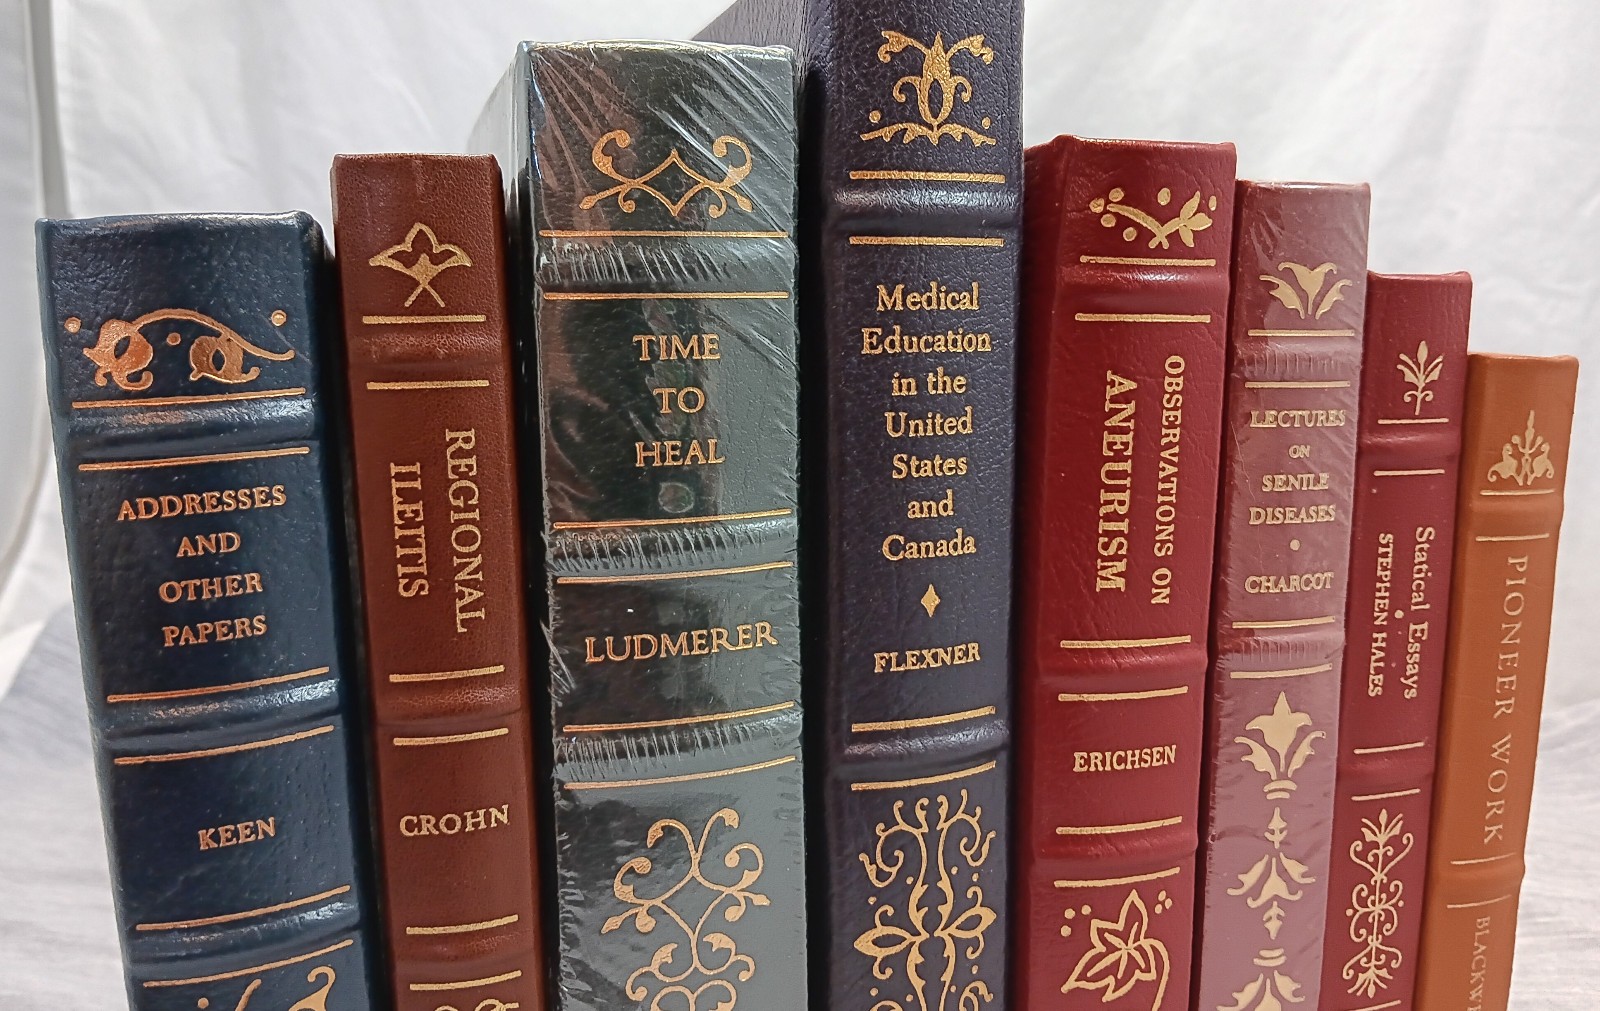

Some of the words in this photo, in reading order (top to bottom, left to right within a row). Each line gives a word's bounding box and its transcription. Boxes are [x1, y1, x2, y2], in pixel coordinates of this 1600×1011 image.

[876, 281, 980, 311] Medical
[632, 333, 722, 362] TIME
[861, 327, 992, 355] Education
[891, 373, 918, 397] in
[927, 367, 967, 395] the
[653, 387, 706, 414] TO
[884, 407, 973, 438] United
[1250, 409, 1346, 428] LECTURES
[635, 439, 726, 468] HEAL
[891, 453, 968, 479] States
[1153, 354, 1186, 557] OBSERVATIONS
[1288, 444, 1311, 459] ON
[1095, 370, 1138, 593] ANEURISM
[1262, 473, 1330, 492] SENILE
[117, 485, 288, 521] ADDRESSES
[907, 489, 955, 519] and
[1249, 505, 1336, 525] DISEASES
[176, 531, 241, 558] AND
[389, 461, 430, 599] ILEITIS
[444, 428, 486, 634] REGIONAL
[882, 528, 977, 562] Canada
[1150, 567, 1172, 605] ON
[1244, 572, 1335, 594] CHARCOT
[1373, 532, 1395, 626] STEPHEN
[1410, 526, 1437, 612] Statical
[158, 572, 264, 604] OTHER
[162, 614, 268, 648] PAPERS
[584, 621, 779, 664] LUDMERER
[1493, 555, 1528, 719] PIONEER
[873, 641, 981, 675] FLEXNER
[1367, 631, 1388, 698] HALES
[1400, 620, 1430, 700] Essays
[1072, 744, 1178, 774] ERICHSEN
[1484, 733, 1513, 845] WORK
[197, 815, 277, 852] KEEN
[399, 803, 510, 838] CROHN
